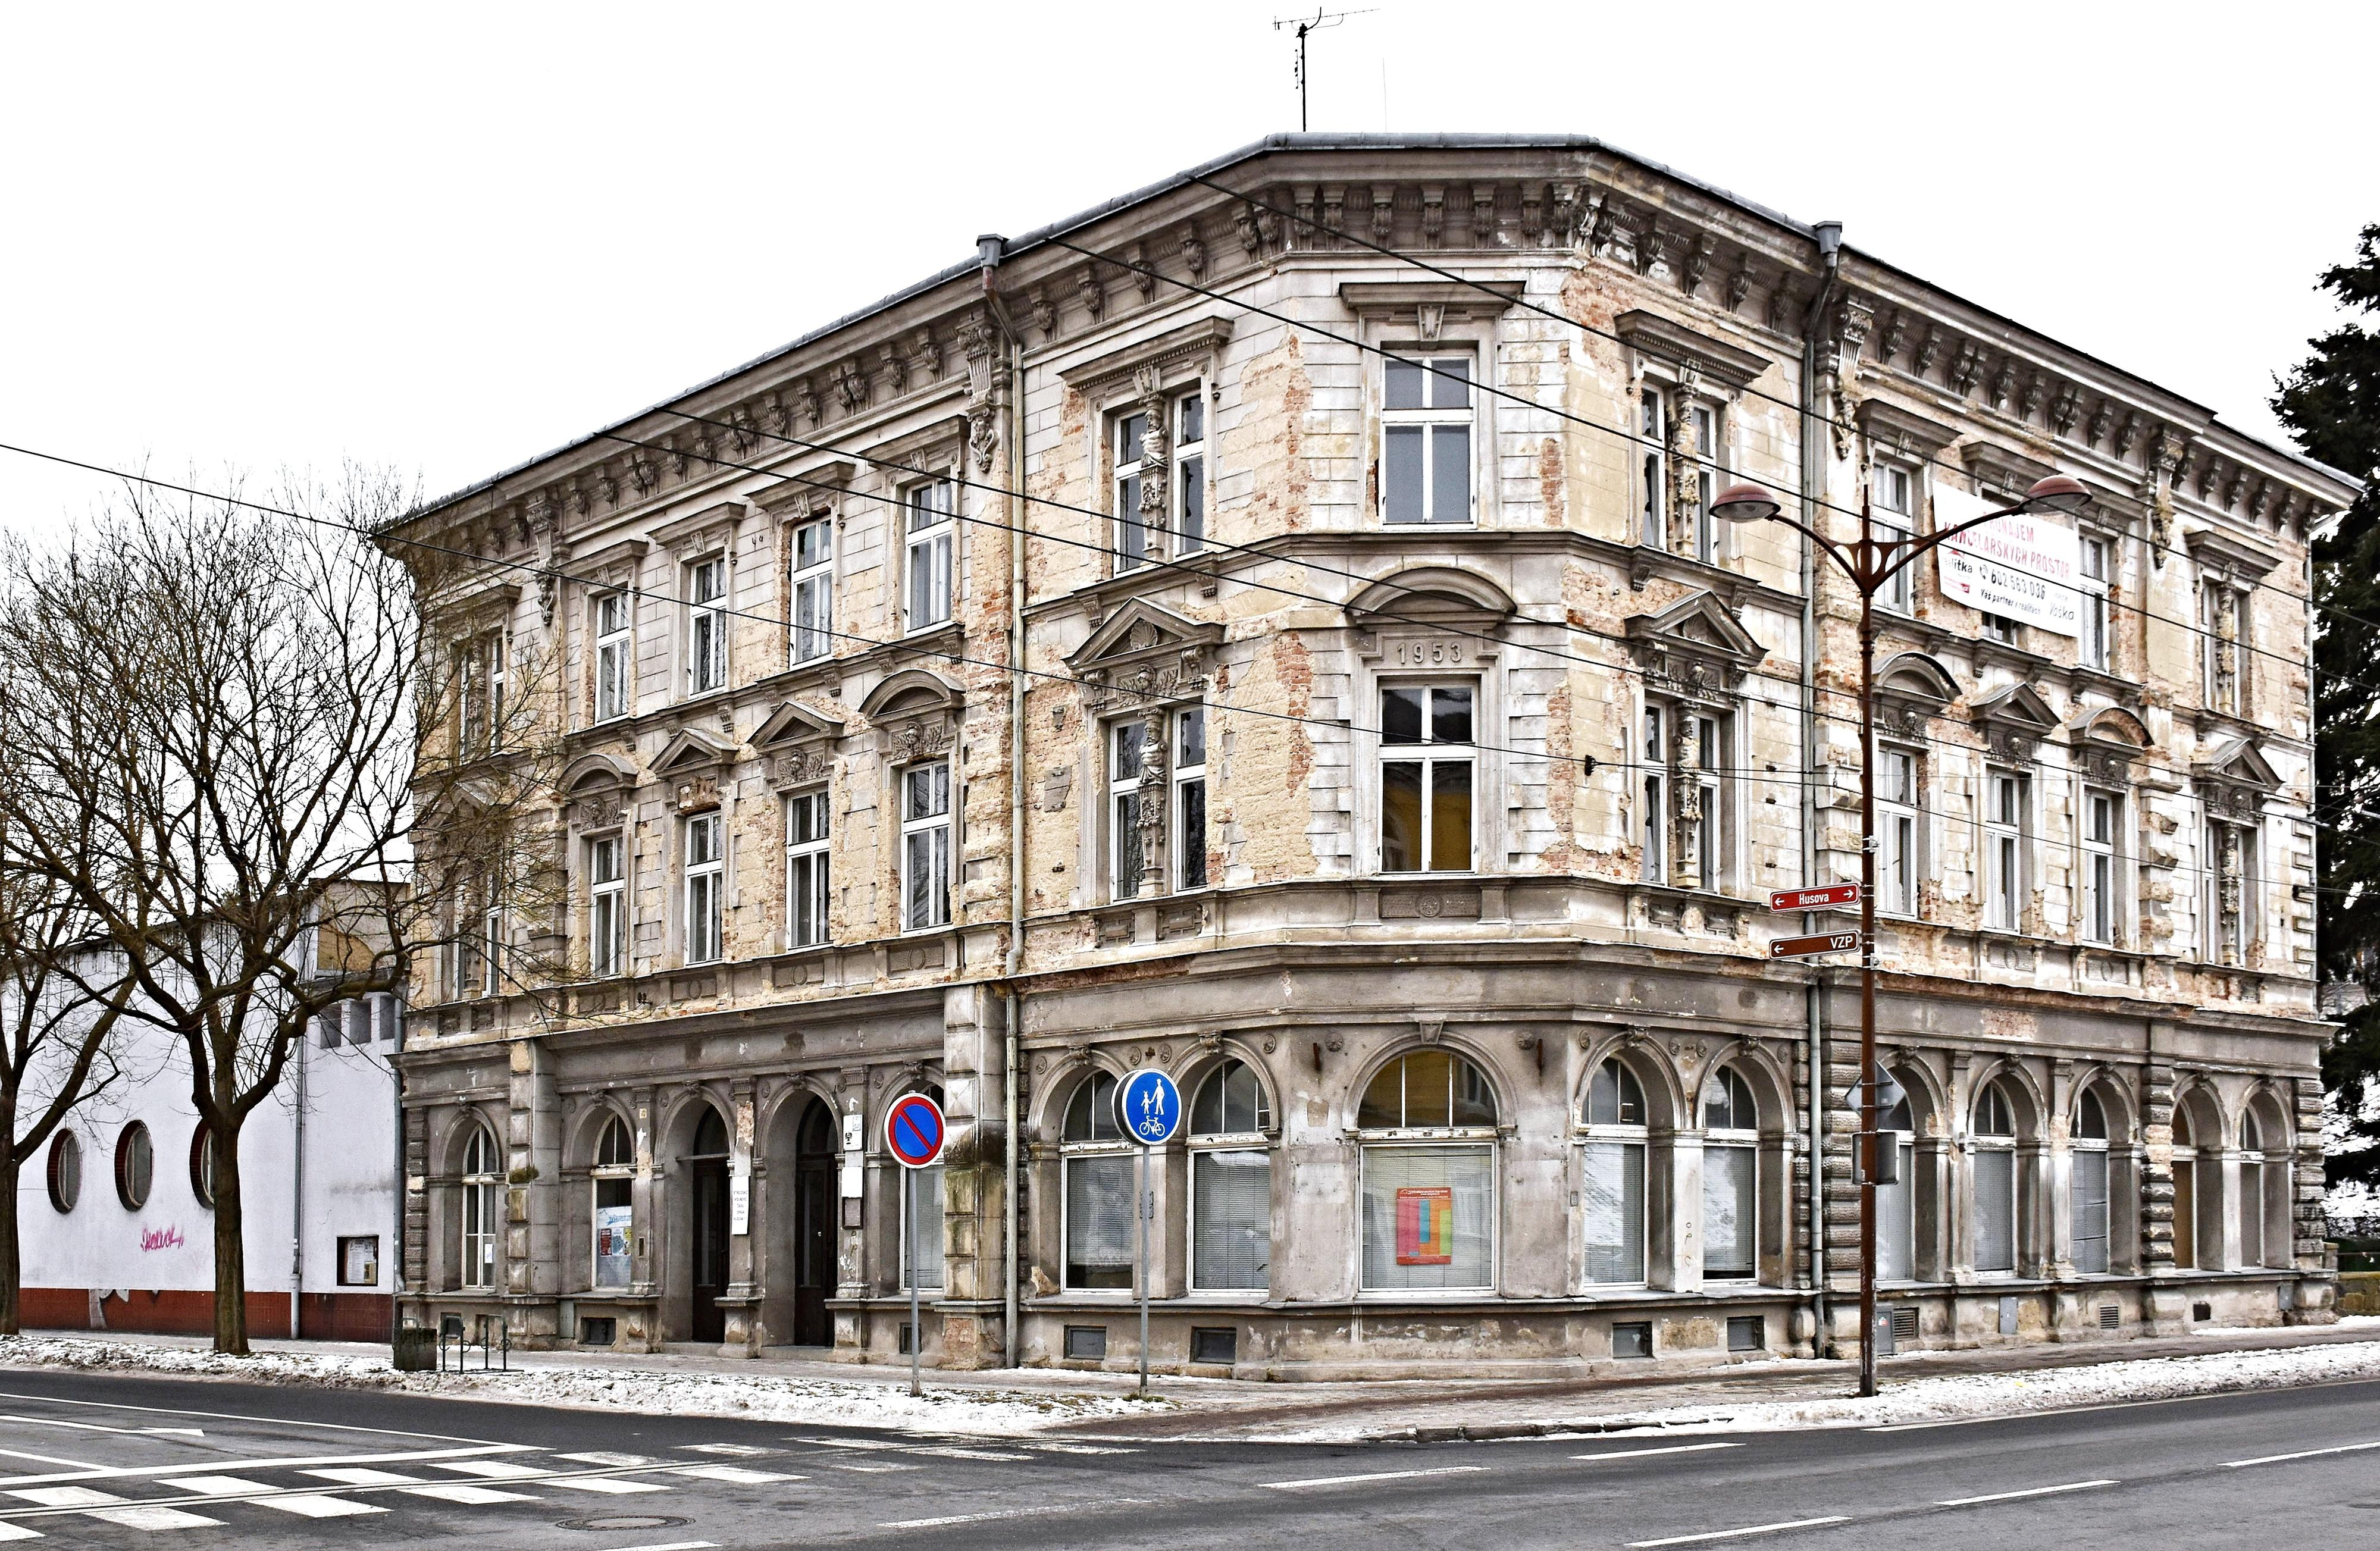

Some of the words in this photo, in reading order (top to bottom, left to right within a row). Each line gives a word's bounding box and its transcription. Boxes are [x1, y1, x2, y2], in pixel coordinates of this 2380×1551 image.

[2030, 551, 2071, 581] PROSTOR
[1991, 569, 2008, 587] 602
[2010, 575, 2027, 594] 563
[2029, 581, 2046, 600] 036
[1991, 594, 2015, 607] partner
[1398, 642, 1462, 665] 1953
[1799, 892, 1829, 905] Husova
[1830, 935, 1853, 950] VZP
